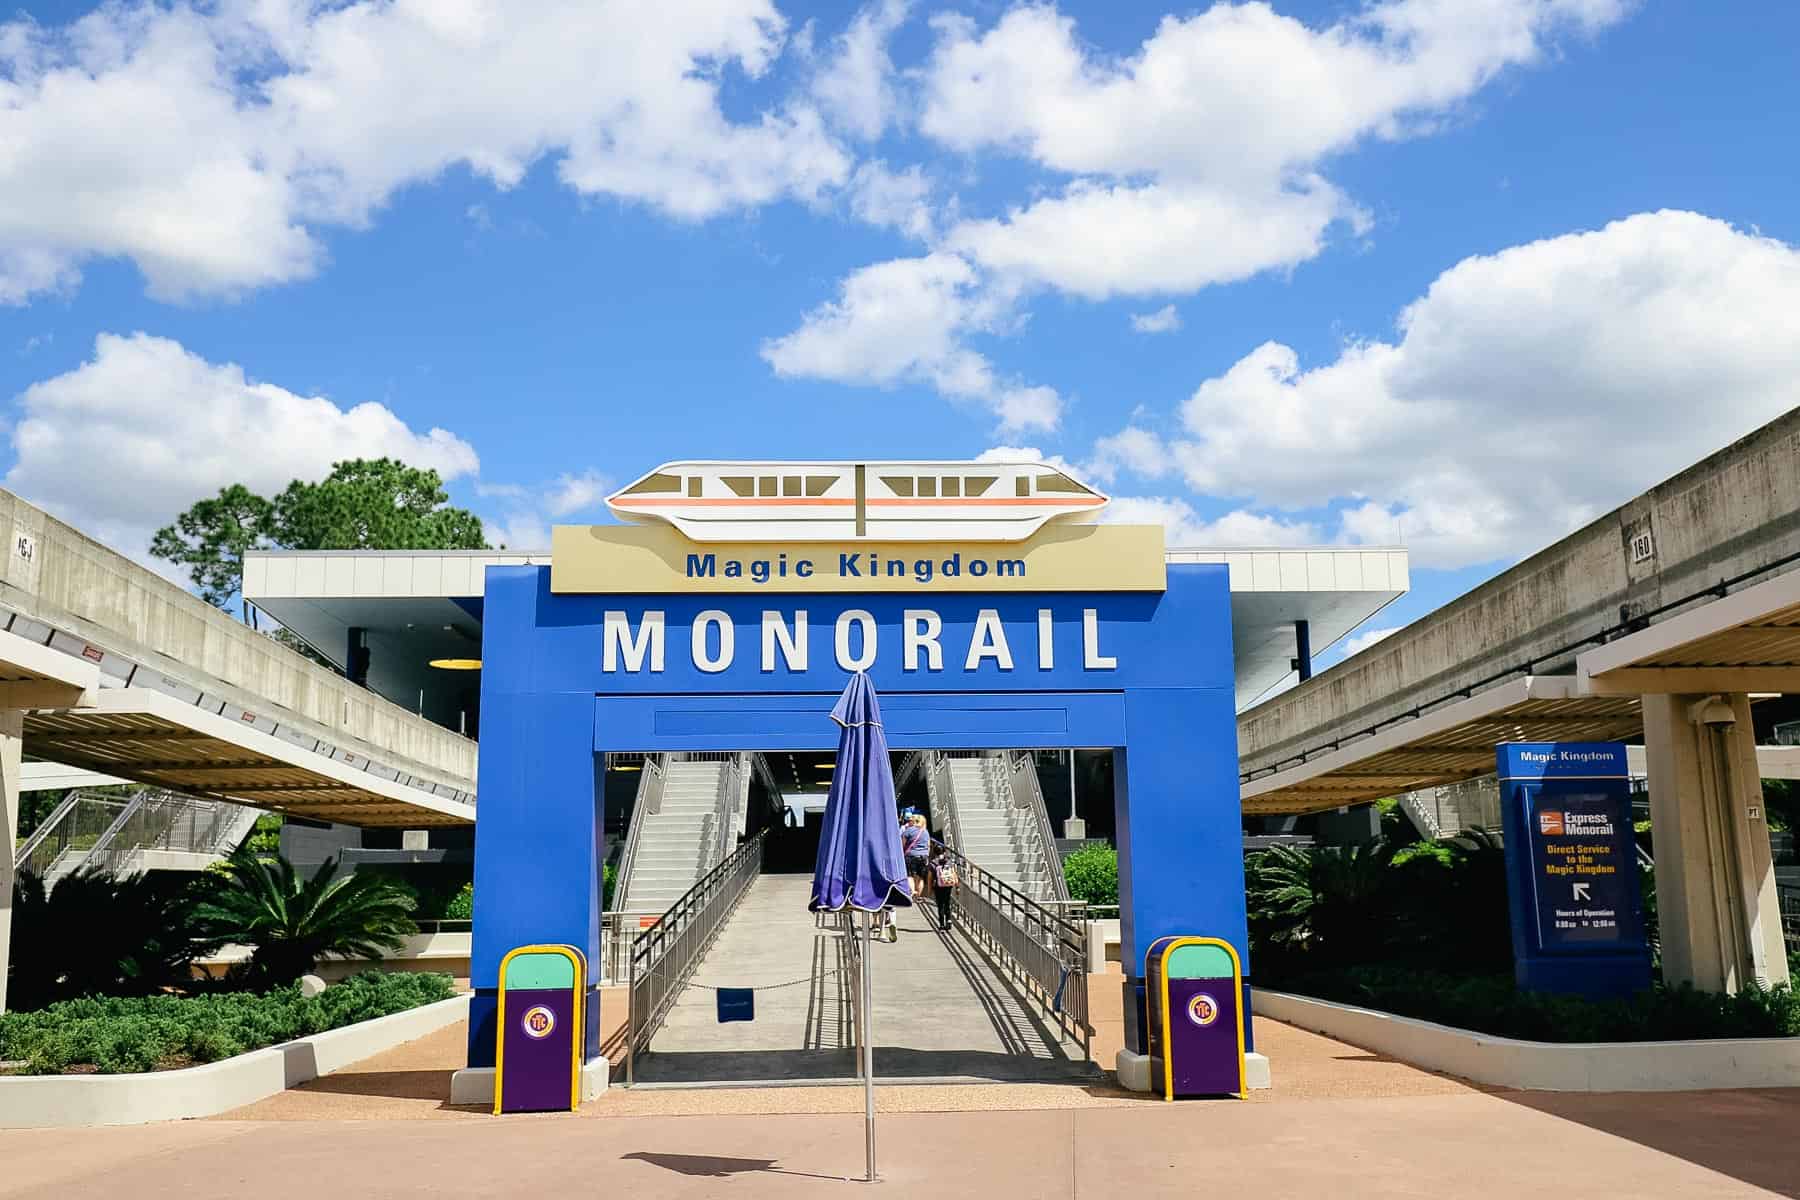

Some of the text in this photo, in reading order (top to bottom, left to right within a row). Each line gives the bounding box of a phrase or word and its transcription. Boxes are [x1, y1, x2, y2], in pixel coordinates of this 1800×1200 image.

[1634, 536, 1650, 559] 160
[686, 553, 1026, 583] Magic Kingdom
[602, 608, 1118, 674] MONORAIL
[1520, 752, 1614, 763] Magic Kingdom
[1564, 812, 1608, 825] Express
[1565, 824, 1614, 835] Monorail
[1546, 845, 1611, 855] Direct Service
[1567, 855, 1593, 864] to the
[1546, 865, 1616, 876] Magic Kingdom
